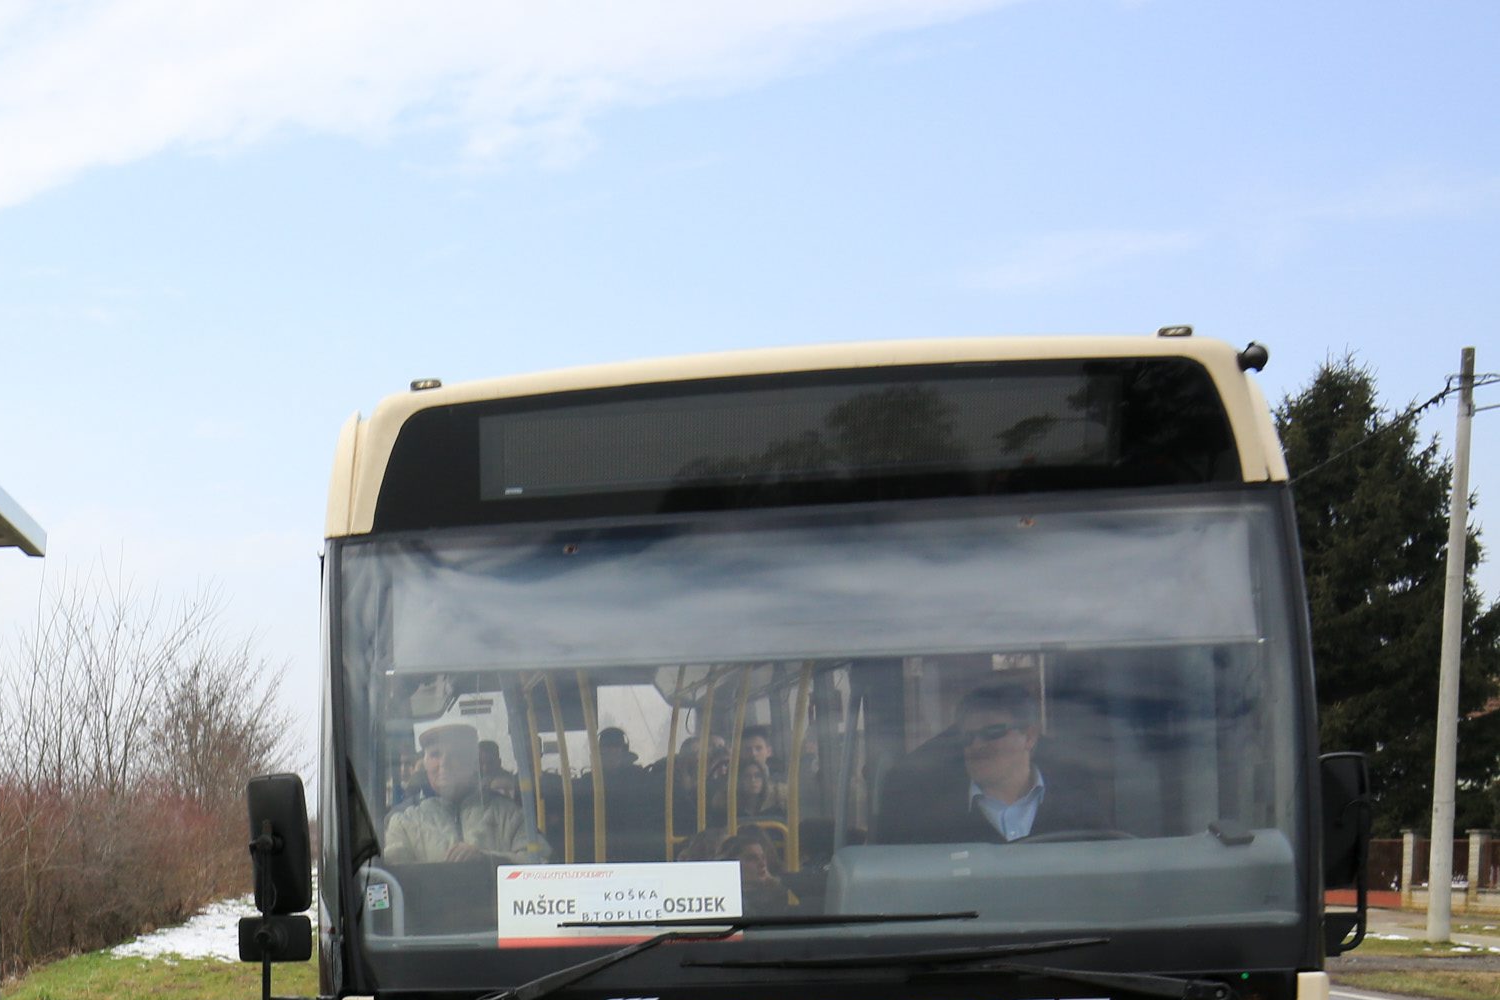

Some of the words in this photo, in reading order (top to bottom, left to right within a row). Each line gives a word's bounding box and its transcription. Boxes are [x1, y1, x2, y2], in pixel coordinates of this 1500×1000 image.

[603, 889, 659, 902] KOŠKA
[513, 894, 576, 916] NAŠICE
[663, 896, 726, 914] OSIJEK
